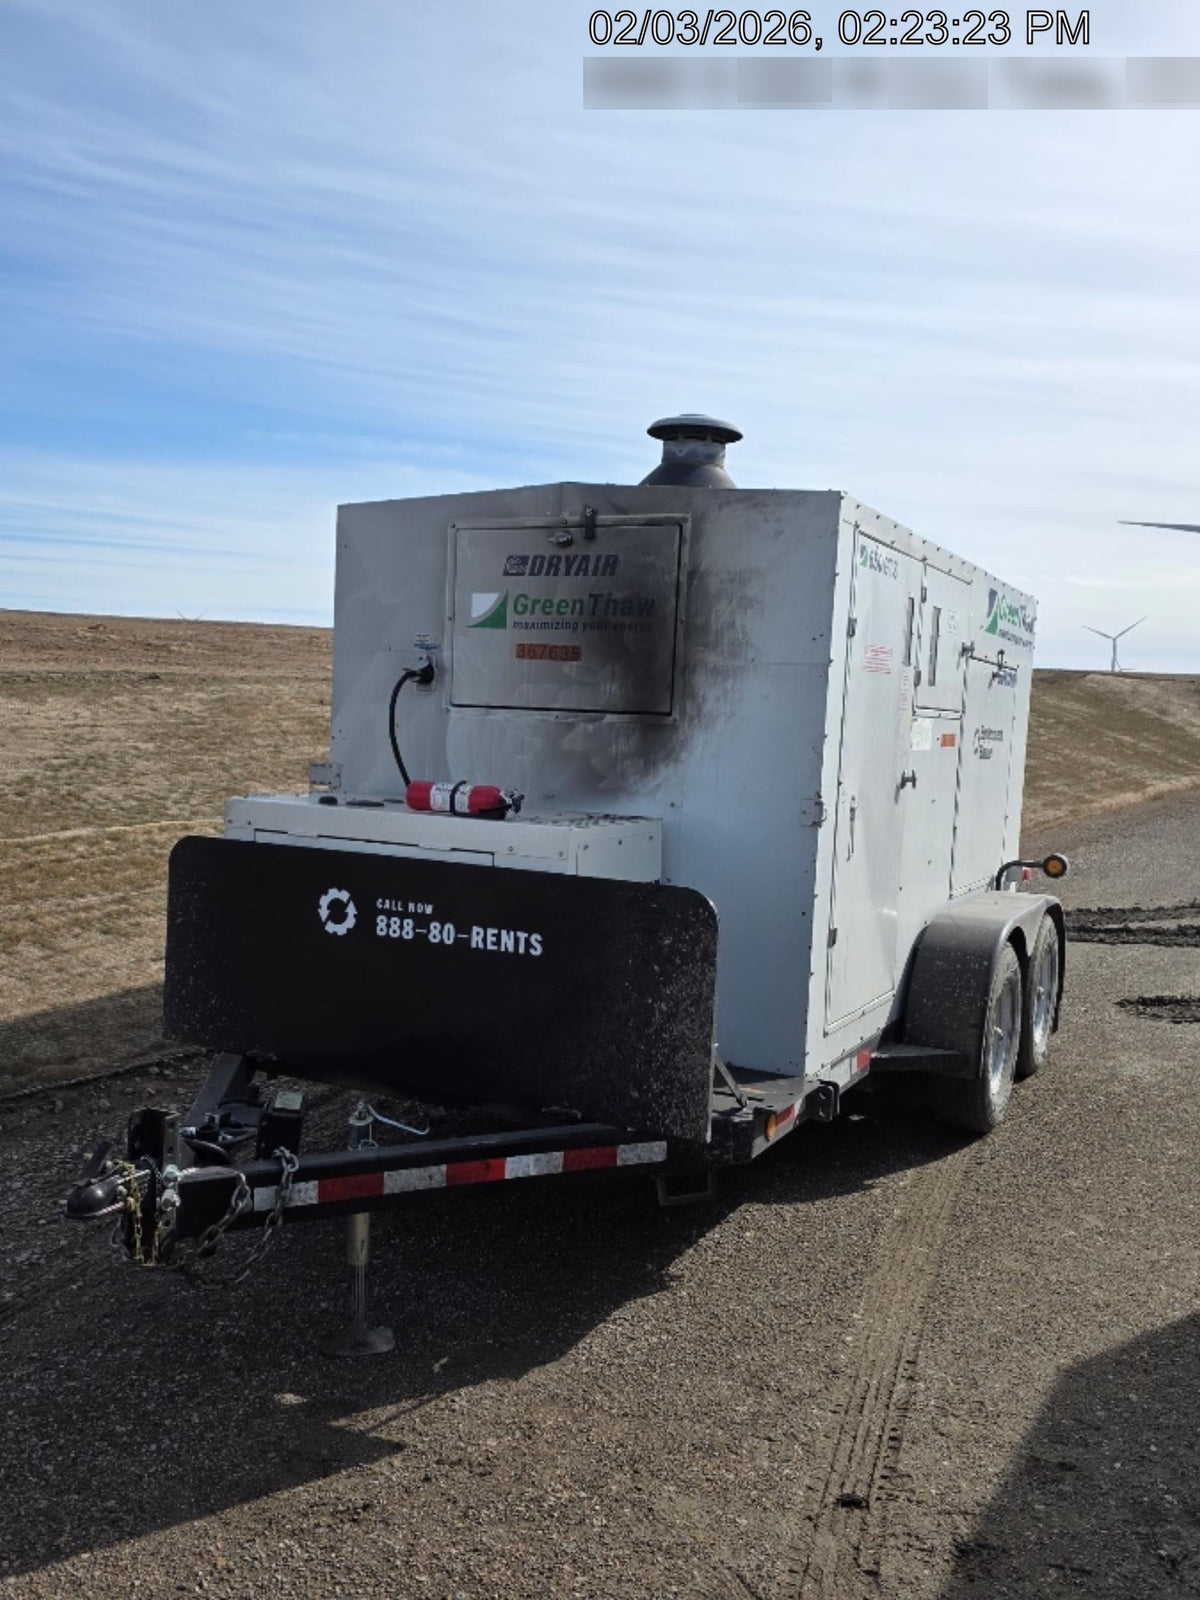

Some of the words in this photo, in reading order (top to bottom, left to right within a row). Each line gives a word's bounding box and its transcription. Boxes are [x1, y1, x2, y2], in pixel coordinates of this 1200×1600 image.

[528, 554, 620, 577] DRYAIR
[513, 619, 579, 632] maximizing
[376, 898, 403, 911] CALL
[408, 902, 434, 914] NOW
[376, 915, 543, 956] 888-80-RENTS
